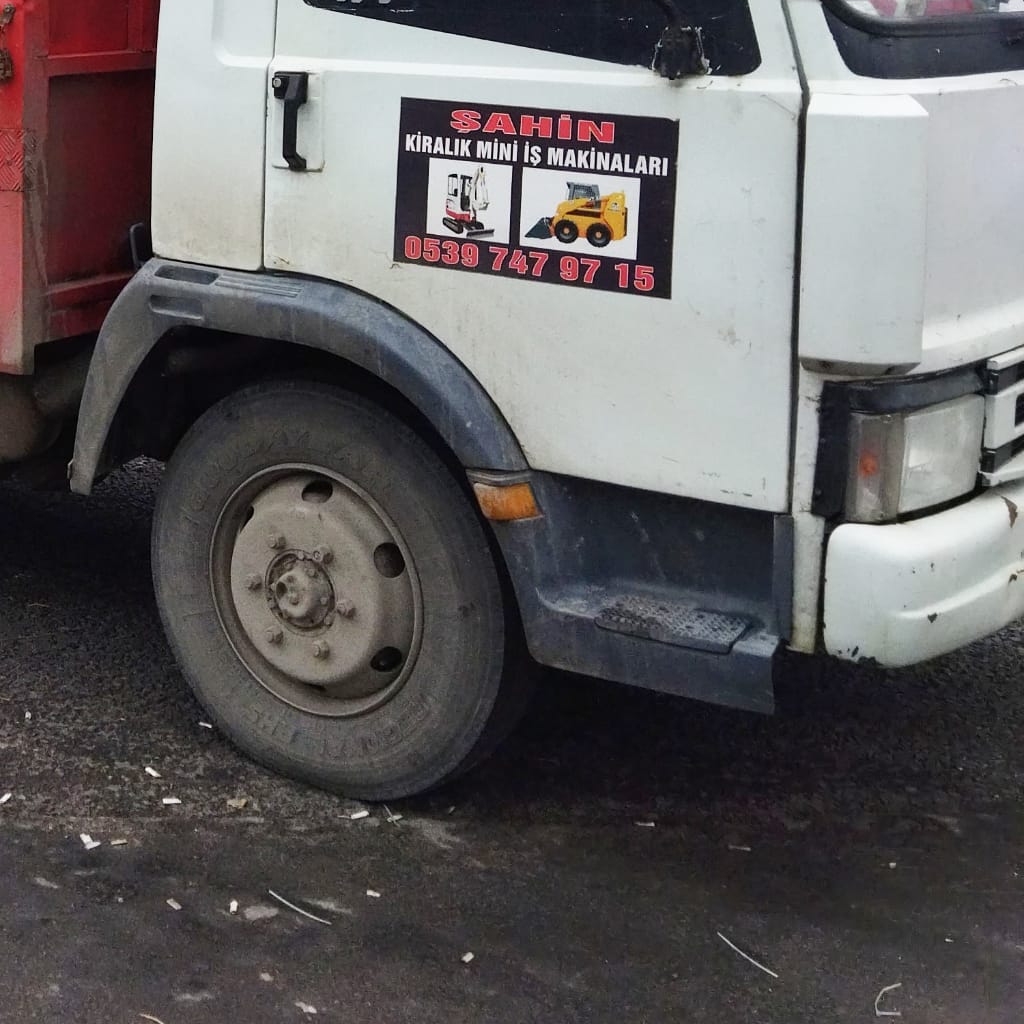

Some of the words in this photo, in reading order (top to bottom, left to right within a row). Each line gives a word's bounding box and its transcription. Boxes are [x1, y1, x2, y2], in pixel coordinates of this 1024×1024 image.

[450, 109, 615, 144] ŞAHİN
[405, 131, 472, 158] KİRALIK
[476, 138, 518, 162] MİNİ
[523, 143, 541, 166] İŞ
[547, 147, 669, 176] MAKİNALARI
[404, 235, 479, 267] 0539
[489, 246, 549, 277] 747
[559, 256, 601, 284] 97
[614, 263, 655, 292] 15
